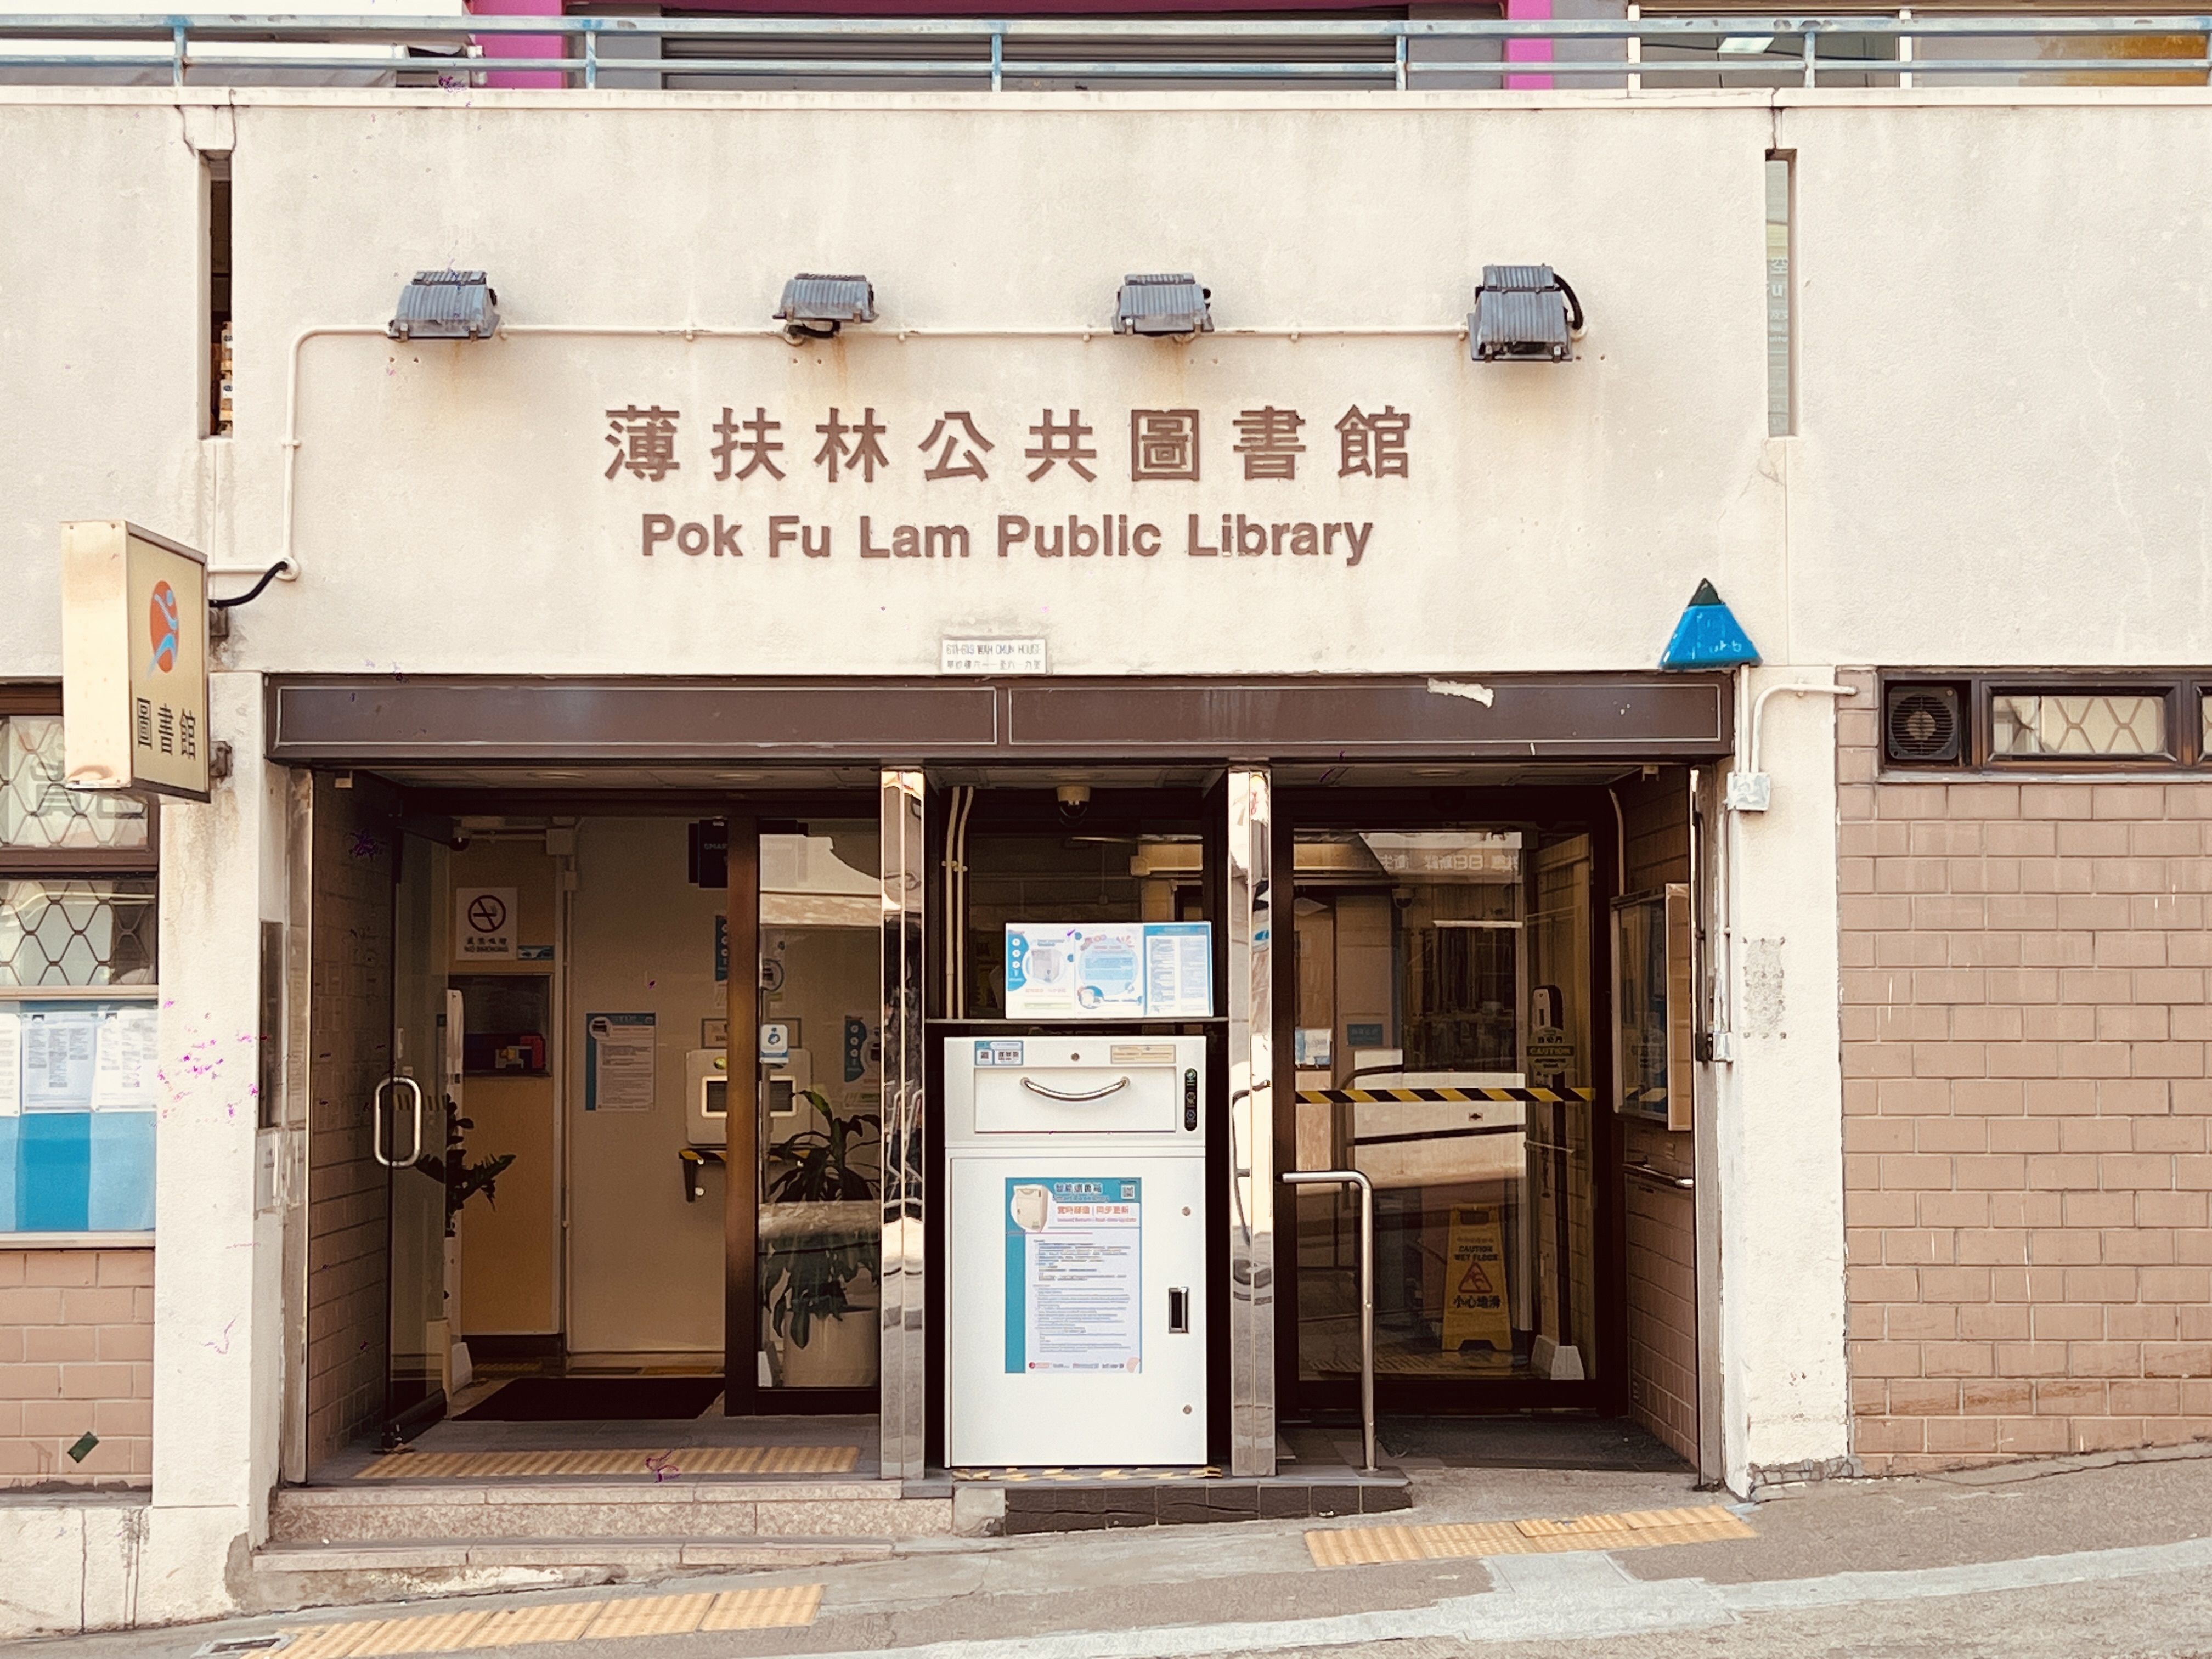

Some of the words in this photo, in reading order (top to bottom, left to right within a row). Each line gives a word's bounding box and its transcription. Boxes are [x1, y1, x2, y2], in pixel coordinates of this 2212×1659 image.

[604, 404, 1411, 483] 薄扶林公共圖書館
[642, 514, 743, 557] Pok
[768, 515, 831, 558] Fu
[859, 515, 969, 558] Lam
[997, 514, 1161, 558] Public
[1188, 513, 1373, 567] Library
[137, 697, 196, 761] 圖書館
[1530, 1047, 1571, 1055] CAUTION
